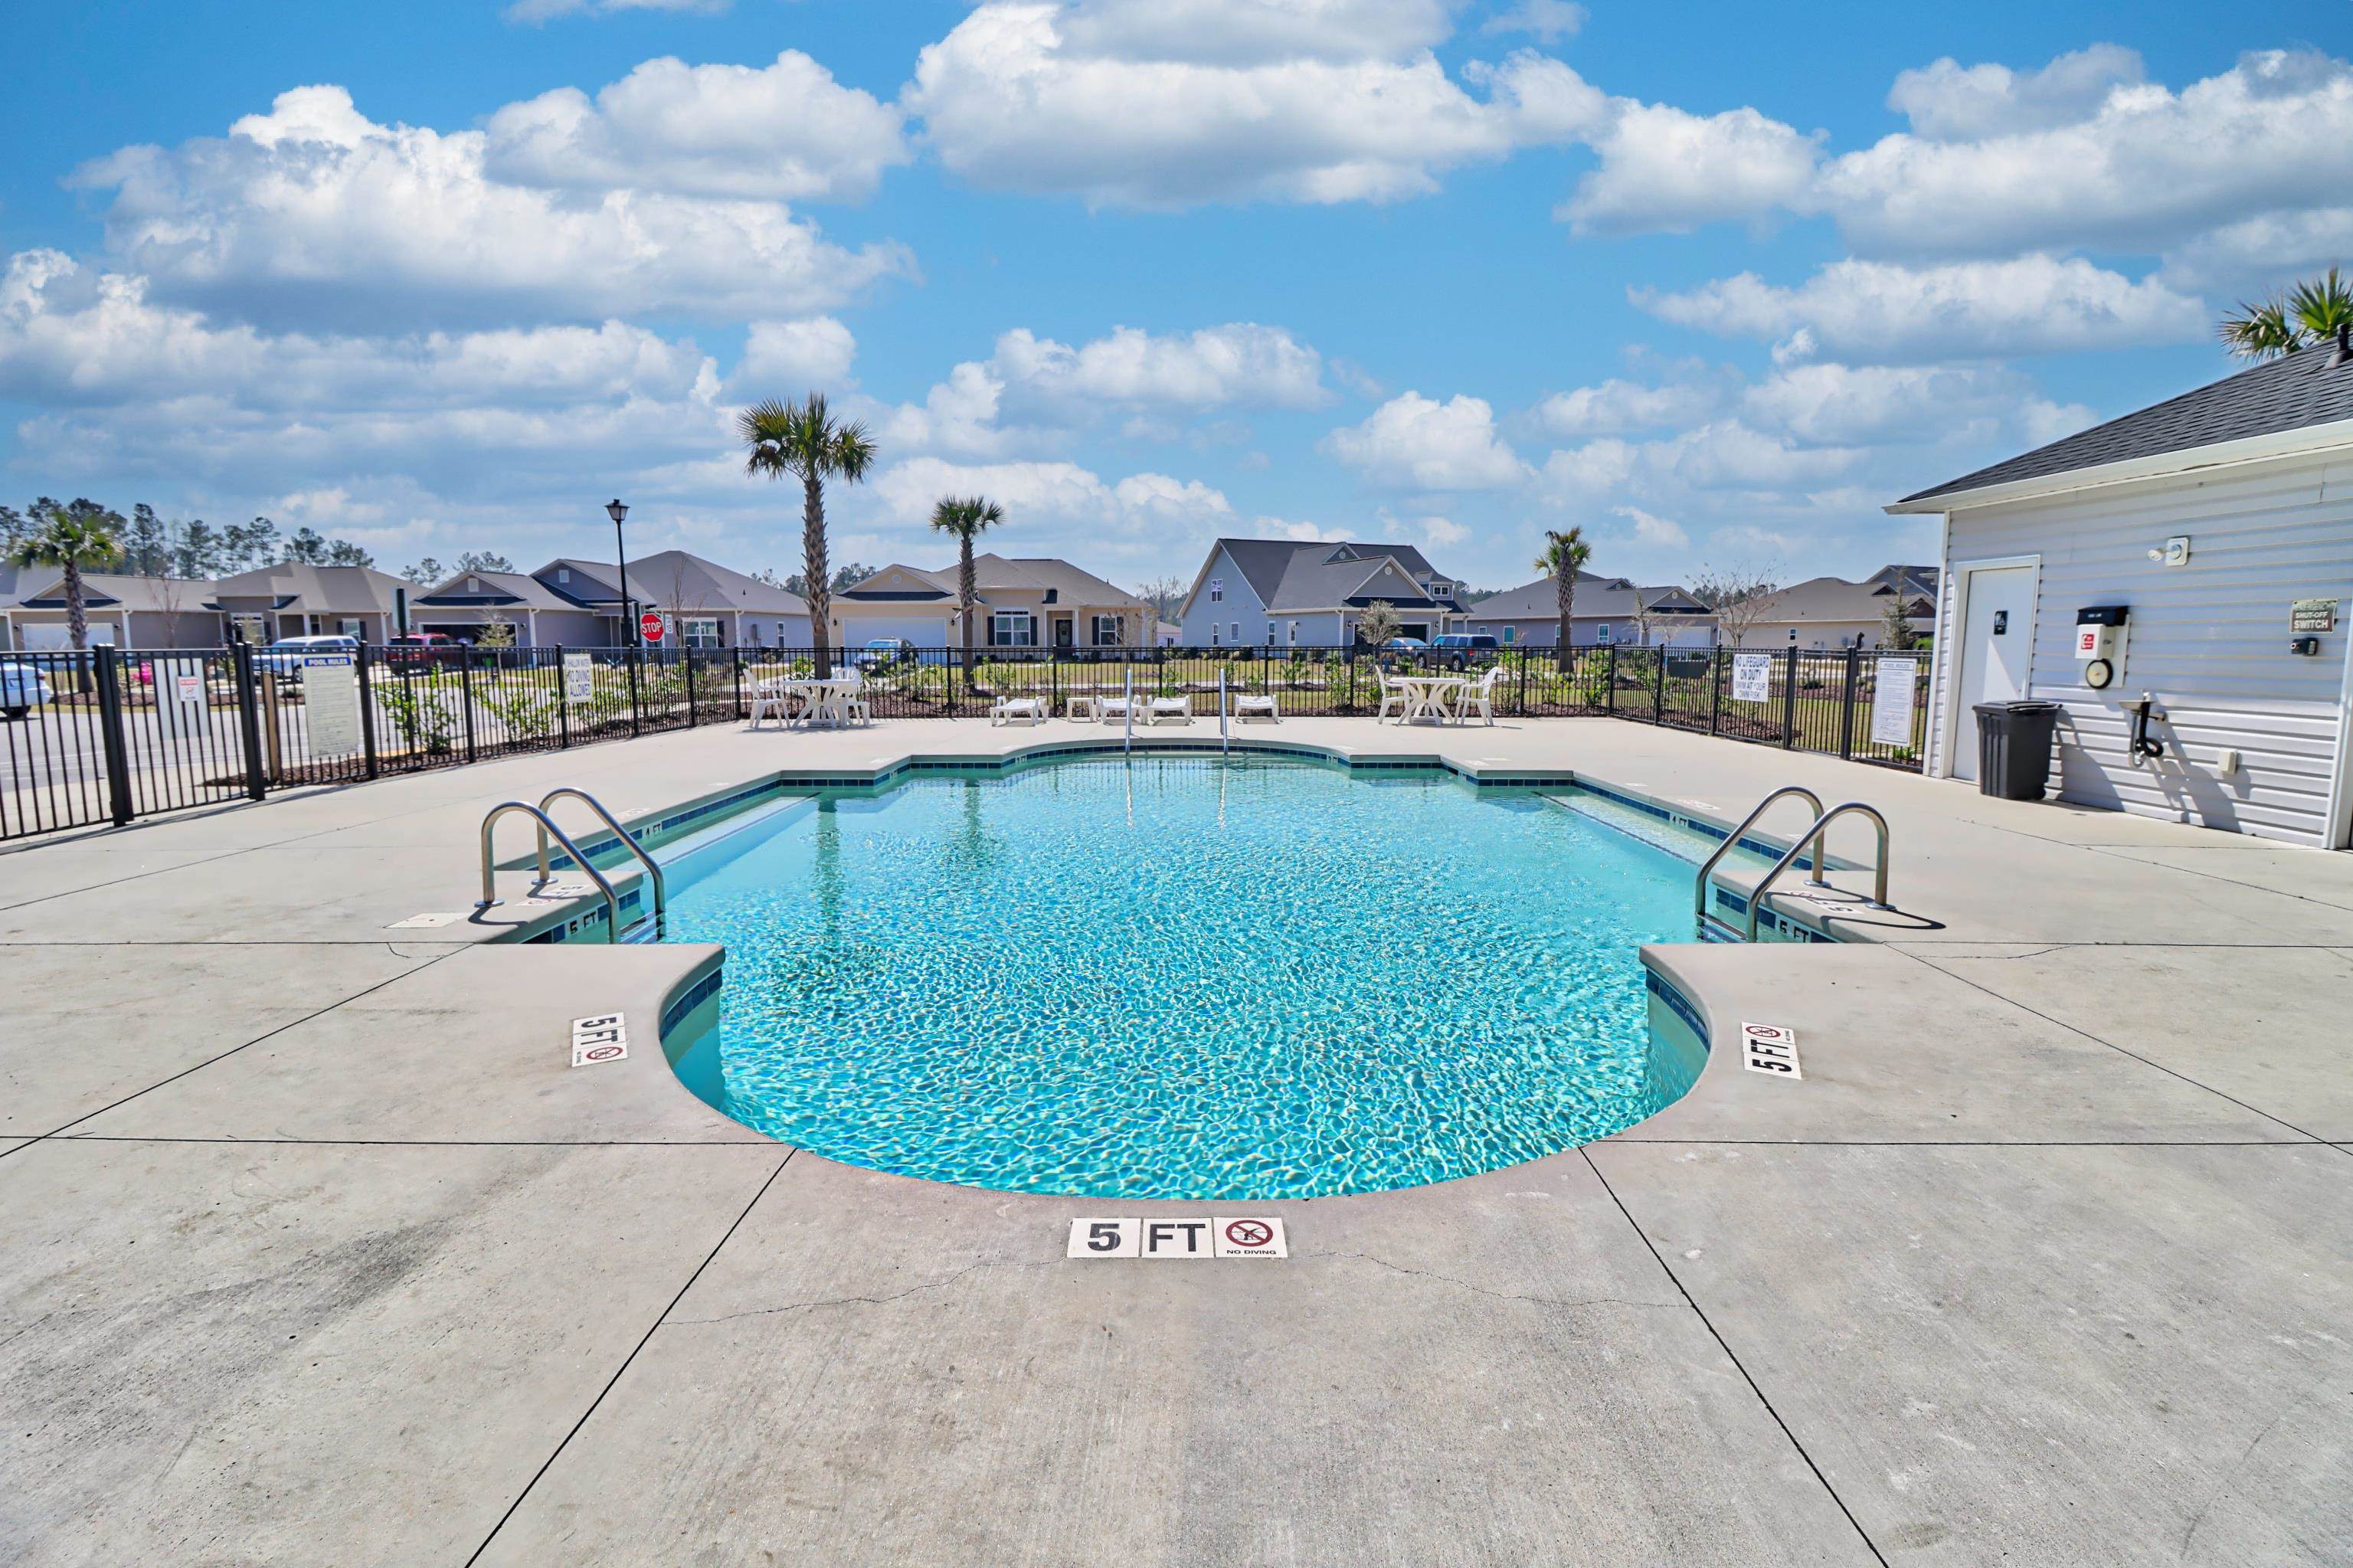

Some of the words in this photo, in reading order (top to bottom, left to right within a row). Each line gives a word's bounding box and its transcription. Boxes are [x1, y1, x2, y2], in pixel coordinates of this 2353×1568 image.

[642, 622, 662, 633] STOP
[2294, 619, 2328, 629] SWITCH
[1735, 656, 1742, 667] NO
[1743, 656, 1769, 668] LIFEGUARD
[575, 669, 591, 683] DIVING
[1740, 669, 1747, 680] ON
[1748, 669, 1762, 680] DUTY
[570, 683, 591, 696] ALLOWED
[569, 920, 578, 935] 5
[583, 911, 596, 928] FT
[1779, 920, 1788, 934] 5
[1793, 926, 1809, 943] FT
[581, 1017, 617, 1028] 5
[581, 1030, 618, 1045] FT
[1750, 1039, 1790, 1059] FT
[1752, 1059, 1792, 1072] 5
[1087, 1223, 1121, 1252] 5
[1149, 1223, 1206, 1252] FT
